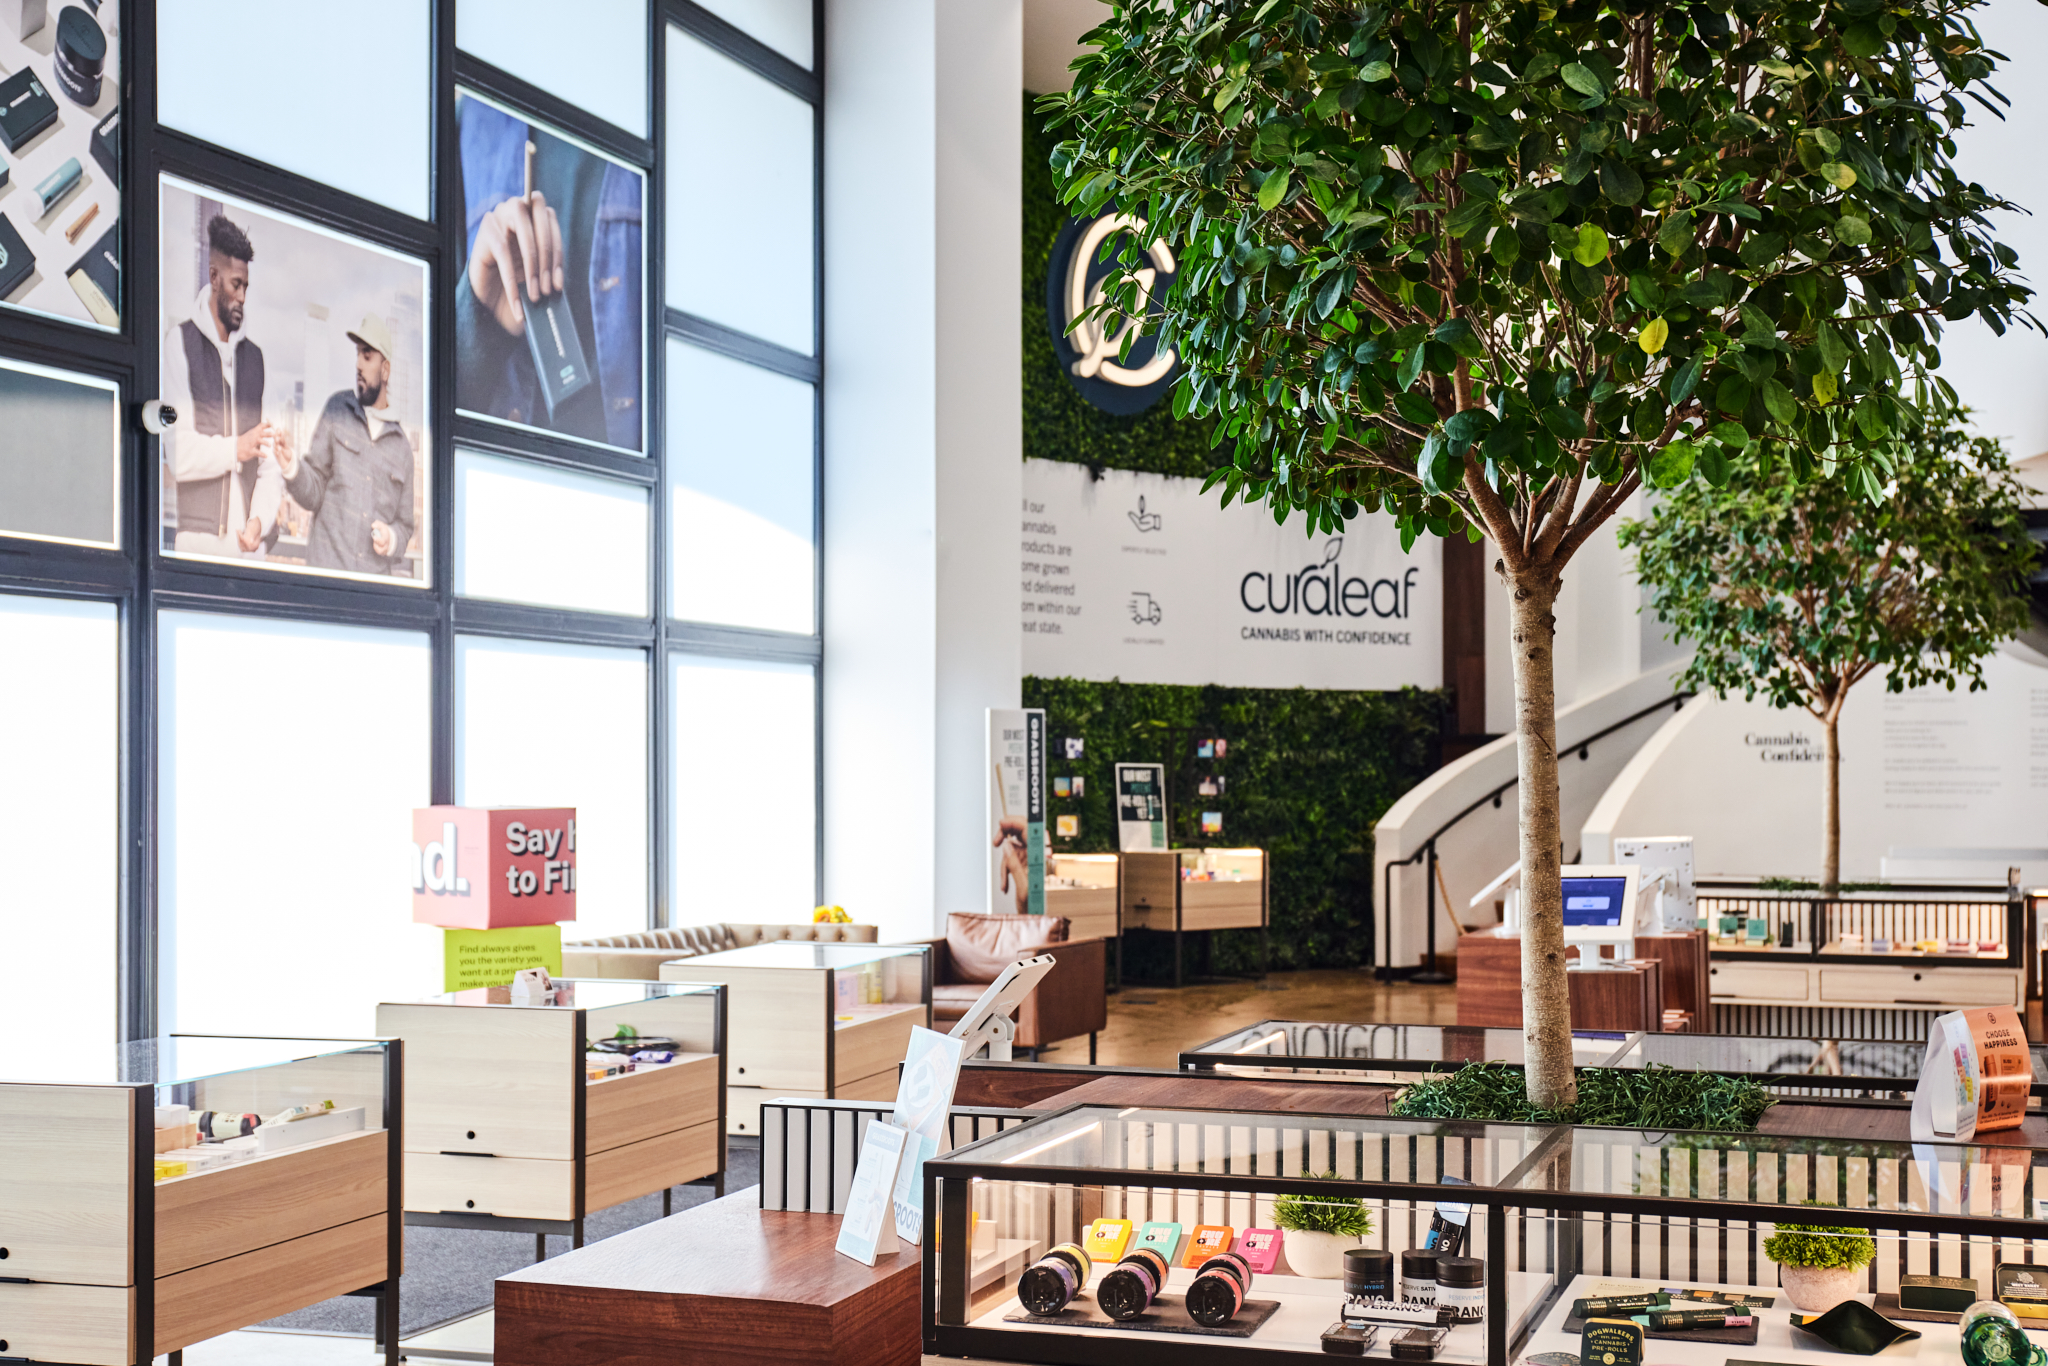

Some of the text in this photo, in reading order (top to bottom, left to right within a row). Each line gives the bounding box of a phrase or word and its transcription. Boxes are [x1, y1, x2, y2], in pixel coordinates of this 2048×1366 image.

[1030, 502, 1045, 513] our
[1022, 521, 1056, 535] annabis
[1021, 541, 1071, 556] roducts are
[1021, 561, 1070, 576] ome grown
[1022, 580, 1075, 596] nd delivered
[1240, 563, 1419, 619] curaleaf
[1021, 602, 1081, 616] om within our
[1241, 626, 1411, 645] CANNABIS WITH CONFIDENCE
[1744, 732, 1810, 746] Cannabis
[1030, 718, 1040, 814] GRASSROOTS
[506, 821, 562, 858] Say
[506, 865, 538, 895] to
[459, 944, 536, 954] Find always gives
[459, 956, 543, 966] you the variety you
[460, 968, 480, 977] want
[483, 968, 492, 976] at
[460, 980, 484, 989] make
[1986, 1029, 2010, 1039] CHOOSE
[1984, 1038, 2018, 1049] HAPPINESS
[1587, 1328, 1635, 1342] DOGWALKERS
